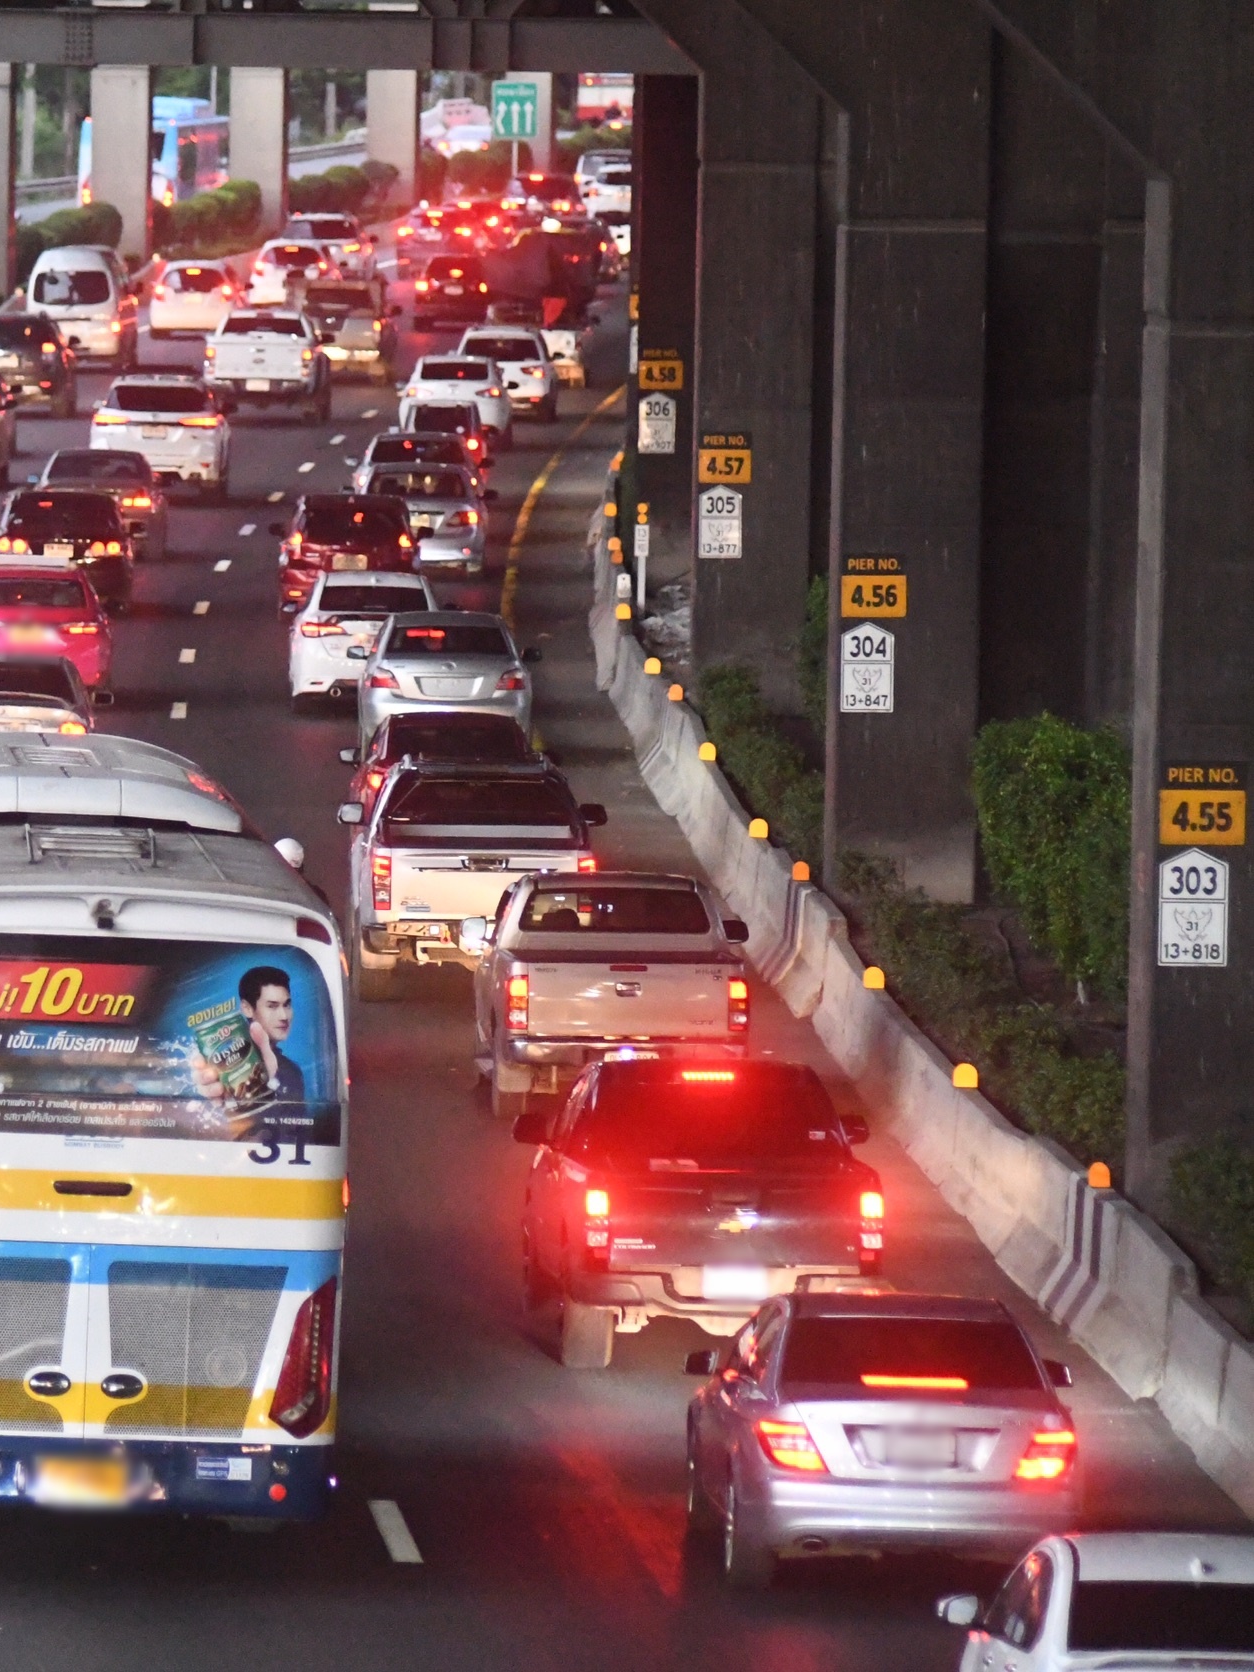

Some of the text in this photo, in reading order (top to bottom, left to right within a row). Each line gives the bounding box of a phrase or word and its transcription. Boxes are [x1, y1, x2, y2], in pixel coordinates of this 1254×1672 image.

[645, 366, 677, 382] 4.58
[645, 401, 670, 417] 306
[703, 435, 747, 446] PIER NO.
[706, 457, 744, 476] 4.57
[706, 496, 736, 514] 305
[702, 543, 738, 554] 13+877
[848, 558, 902, 571] PIER NO.
[851, 584, 898, 608] 4.56
[849, 635, 887, 658] 304
[861, 677, 872, 687] 31
[845, 694, 889, 707] 13+847
[1168, 767, 1239, 783] PIER NO.
[1172, 801, 1233, 832] 4.55
[1169, 866, 1218, 896] 303
[1185, 920, 1199, 932] 31
[1164, 943, 1221, 960] 13+818
[19, 966, 84, 1017] 10
[77, 993, 136, 1018] บาท
[187, 996, 237, 1028] ลองเลย!
[37, 1099, 44, 1108] 2
[247, 1127, 312, 1166] 31
